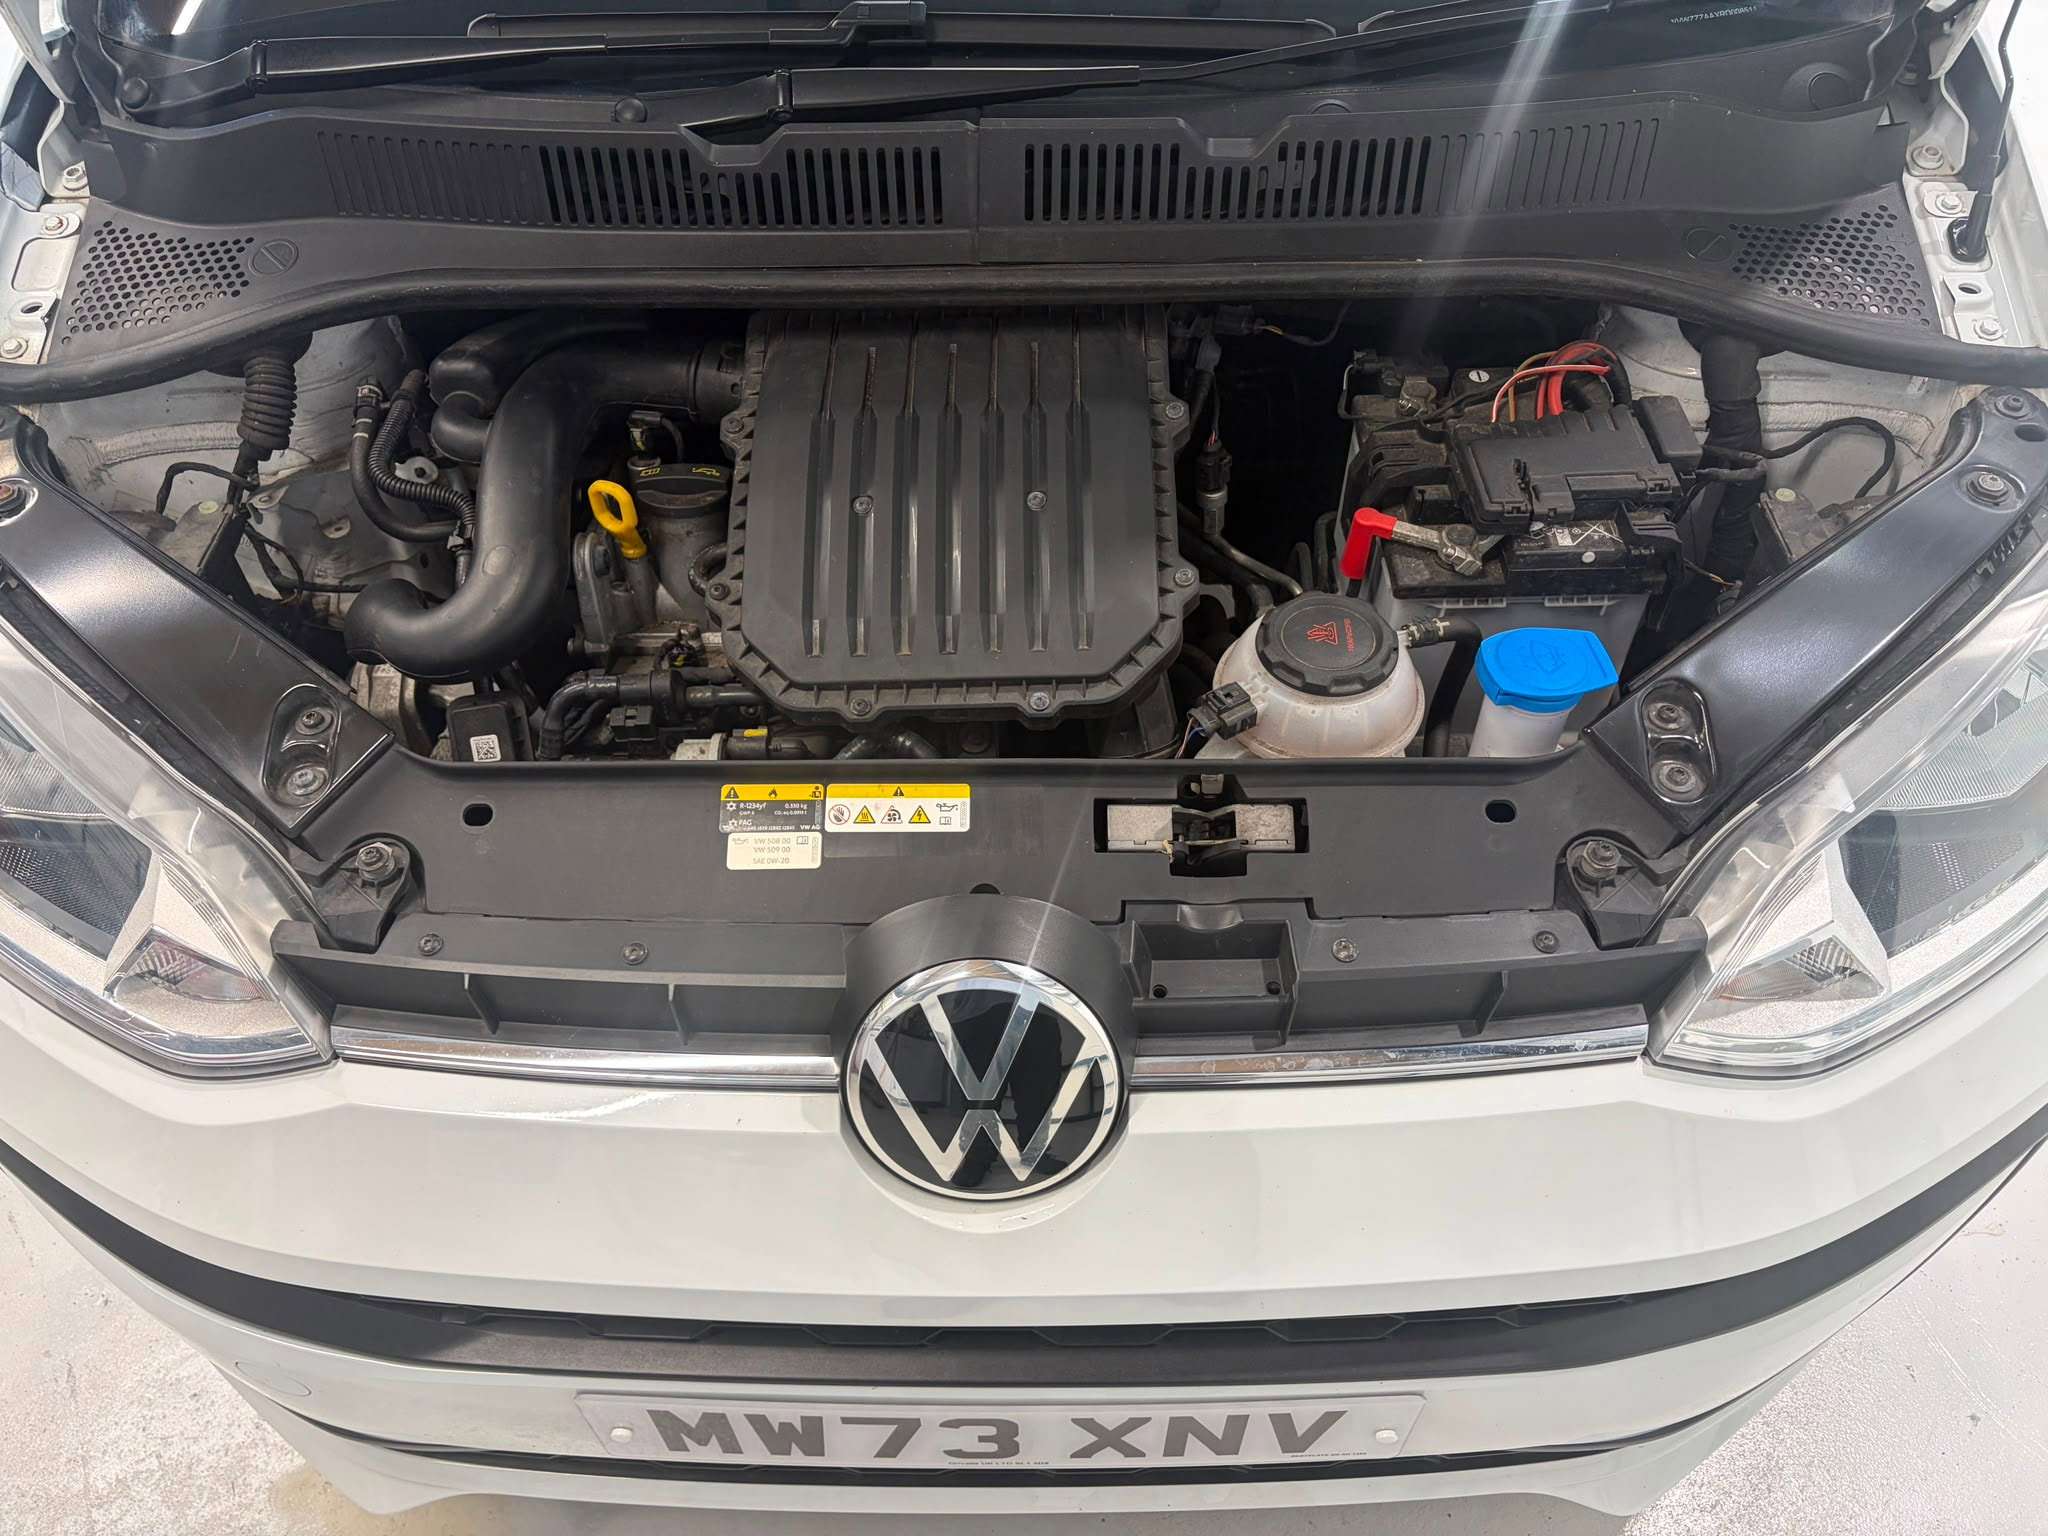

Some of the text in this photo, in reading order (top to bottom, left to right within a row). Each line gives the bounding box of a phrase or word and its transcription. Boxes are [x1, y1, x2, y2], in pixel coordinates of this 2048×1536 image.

[860, 978, 1107, 1184] VW
[646, 1409, 1349, 1459] MW73 XNV
